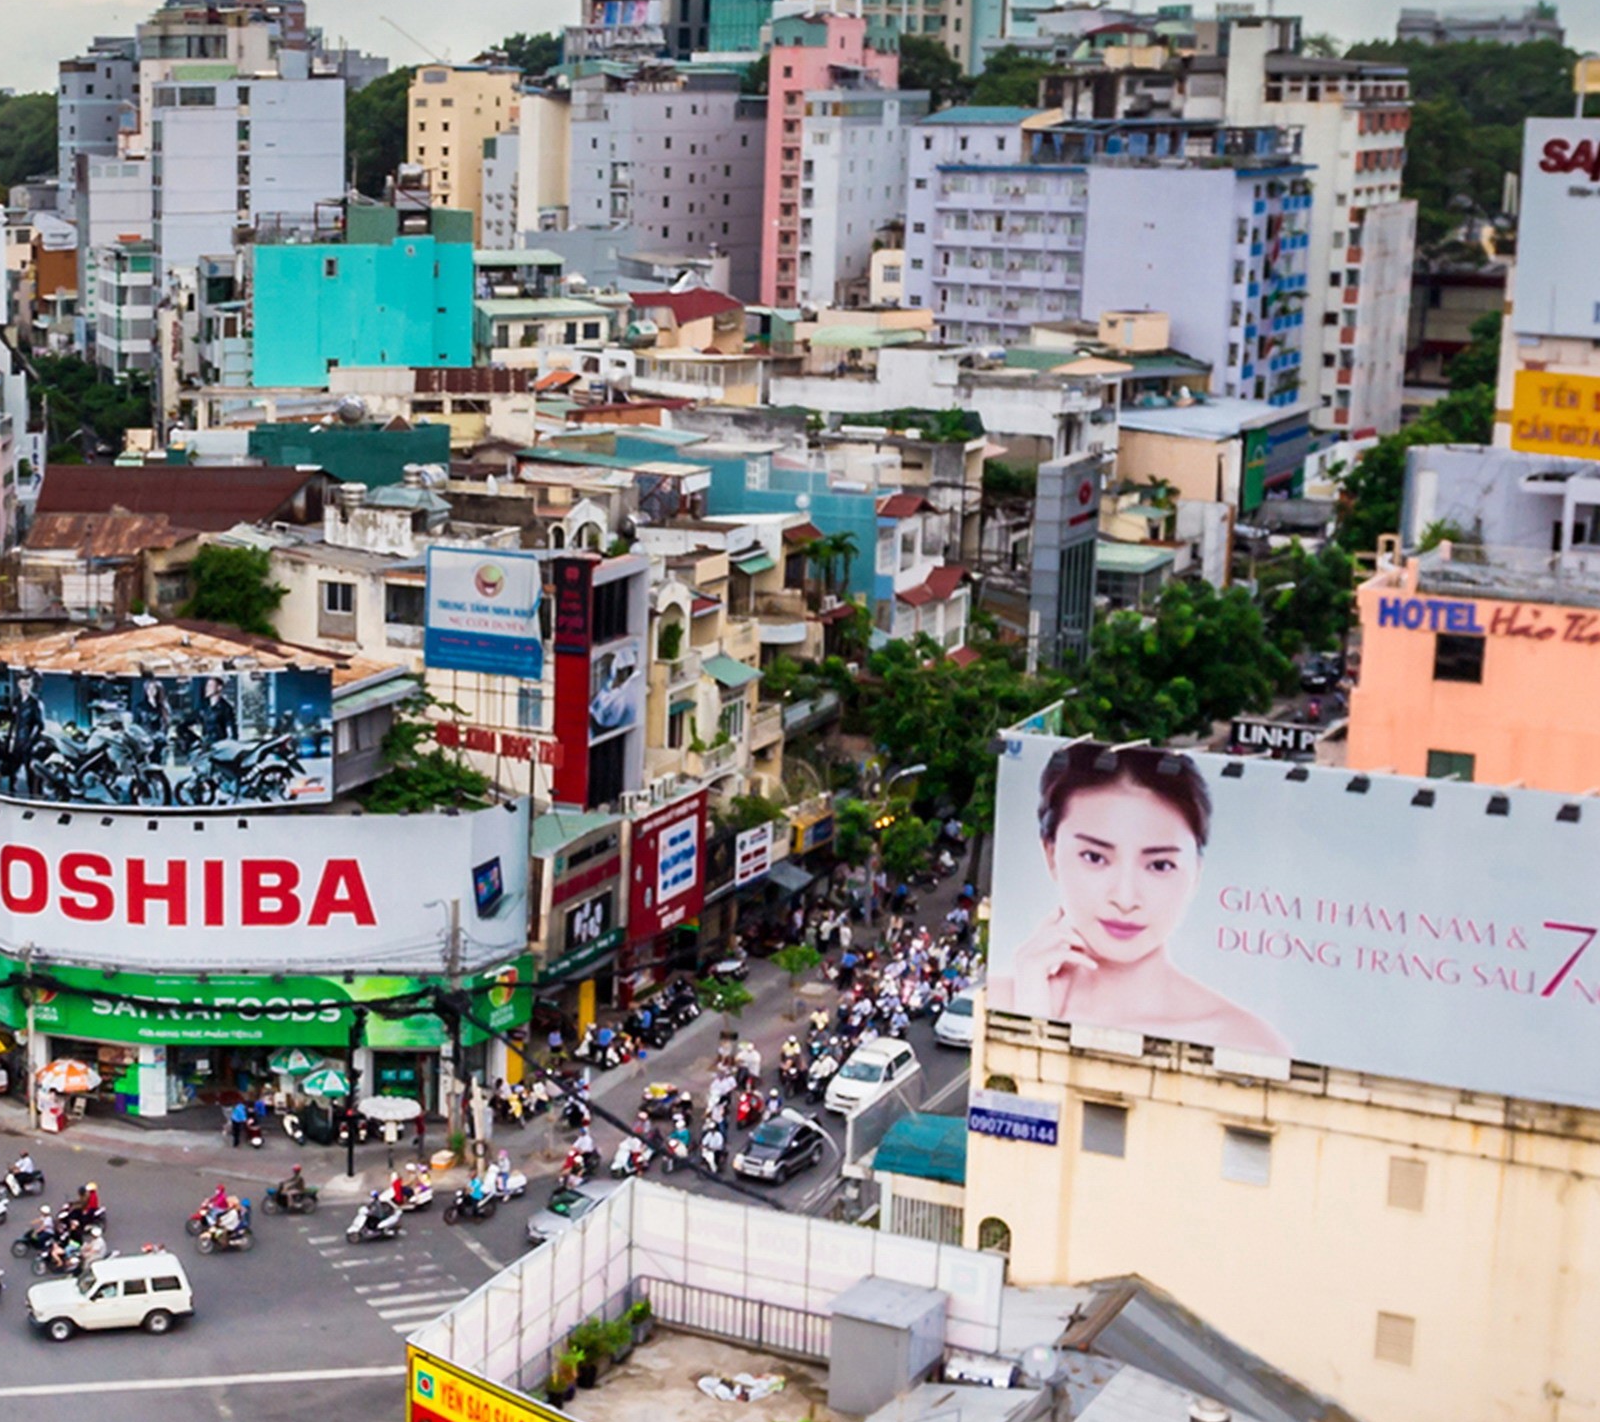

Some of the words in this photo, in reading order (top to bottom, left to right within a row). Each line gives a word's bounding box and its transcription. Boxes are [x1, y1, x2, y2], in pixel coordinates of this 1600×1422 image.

[1377, 596, 1486, 635] HOTEL
[1237, 723, 1297, 749] LINH
[1504, 925, 1529, 952] &
[1471, 960, 1538, 996] SAU
[1539, 919, 1599, 999] 7
